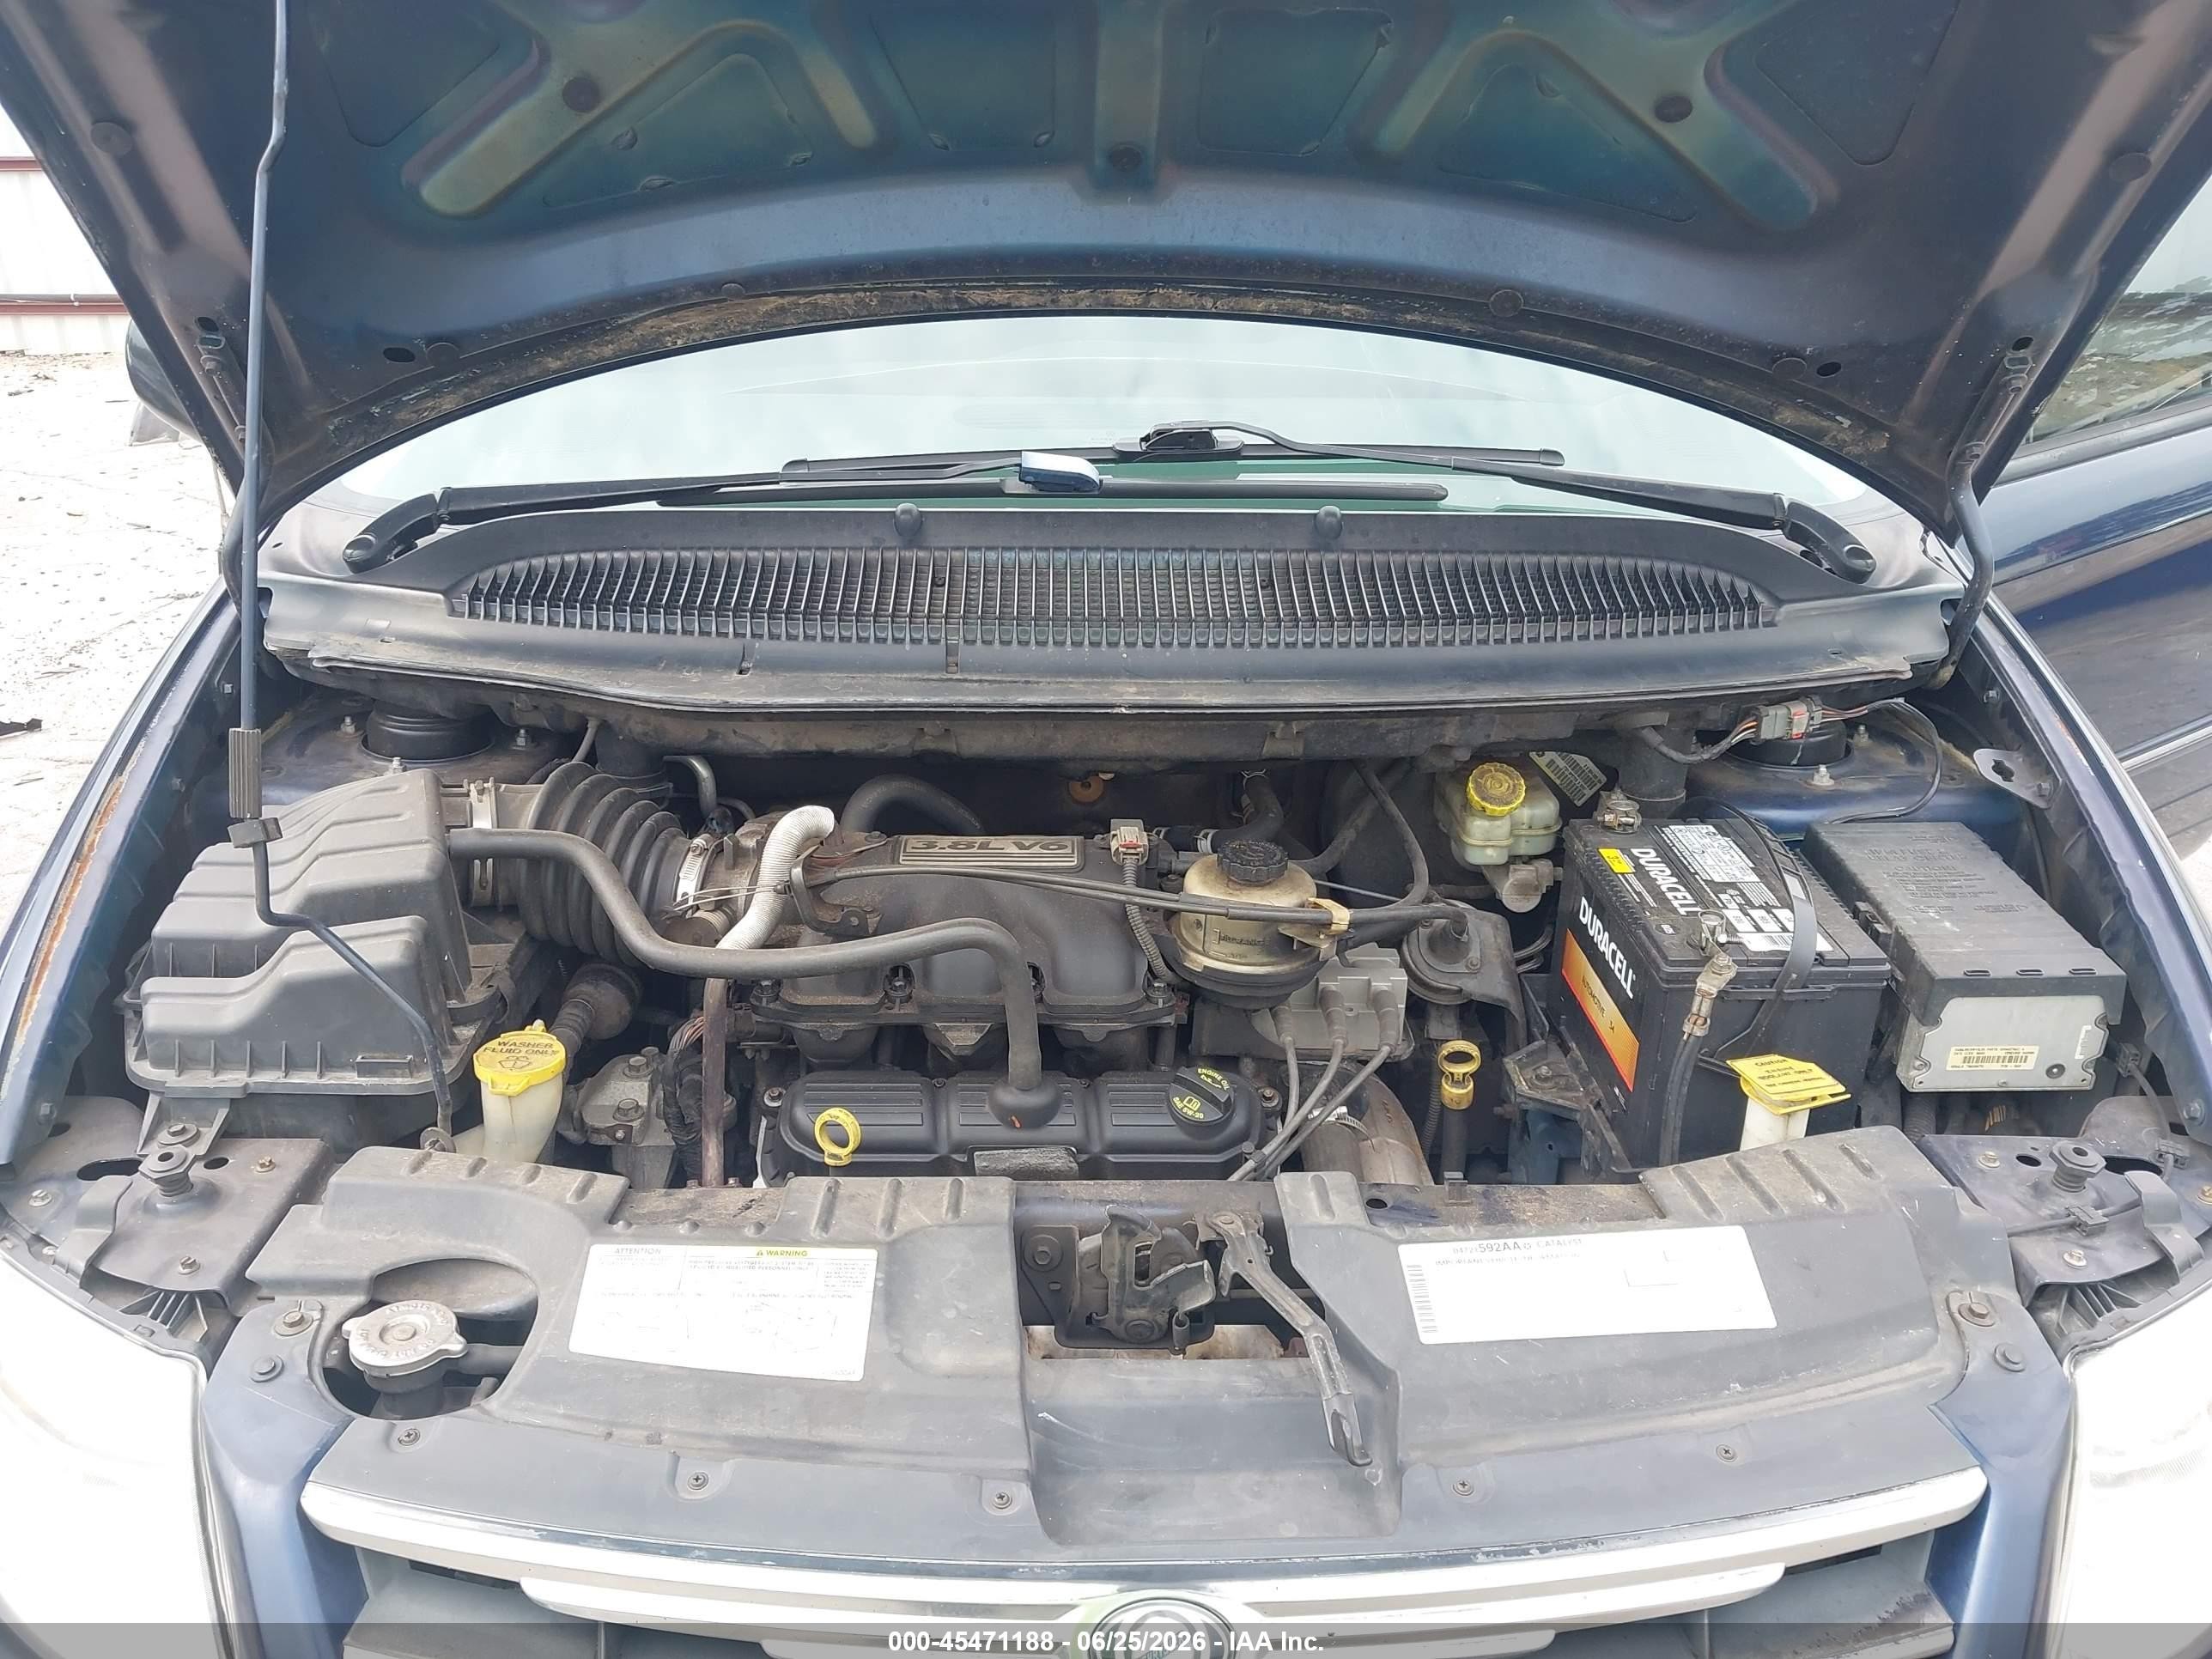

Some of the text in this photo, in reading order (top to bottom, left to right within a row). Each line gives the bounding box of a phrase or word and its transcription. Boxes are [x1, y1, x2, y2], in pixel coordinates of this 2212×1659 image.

[911, 839, 1069, 852] 3.8L V6
[1630, 848, 1703, 916] DURACELL
[1579, 896, 1634, 1000] DURACELL
[1581, 975, 1607, 1018] AUTOMOTIVE
[483, 1046, 522, 1054] FLUID
[498, 1041, 554, 1049] WASHER
[1197, 1067, 1231, 1091] ENGINE OIL
